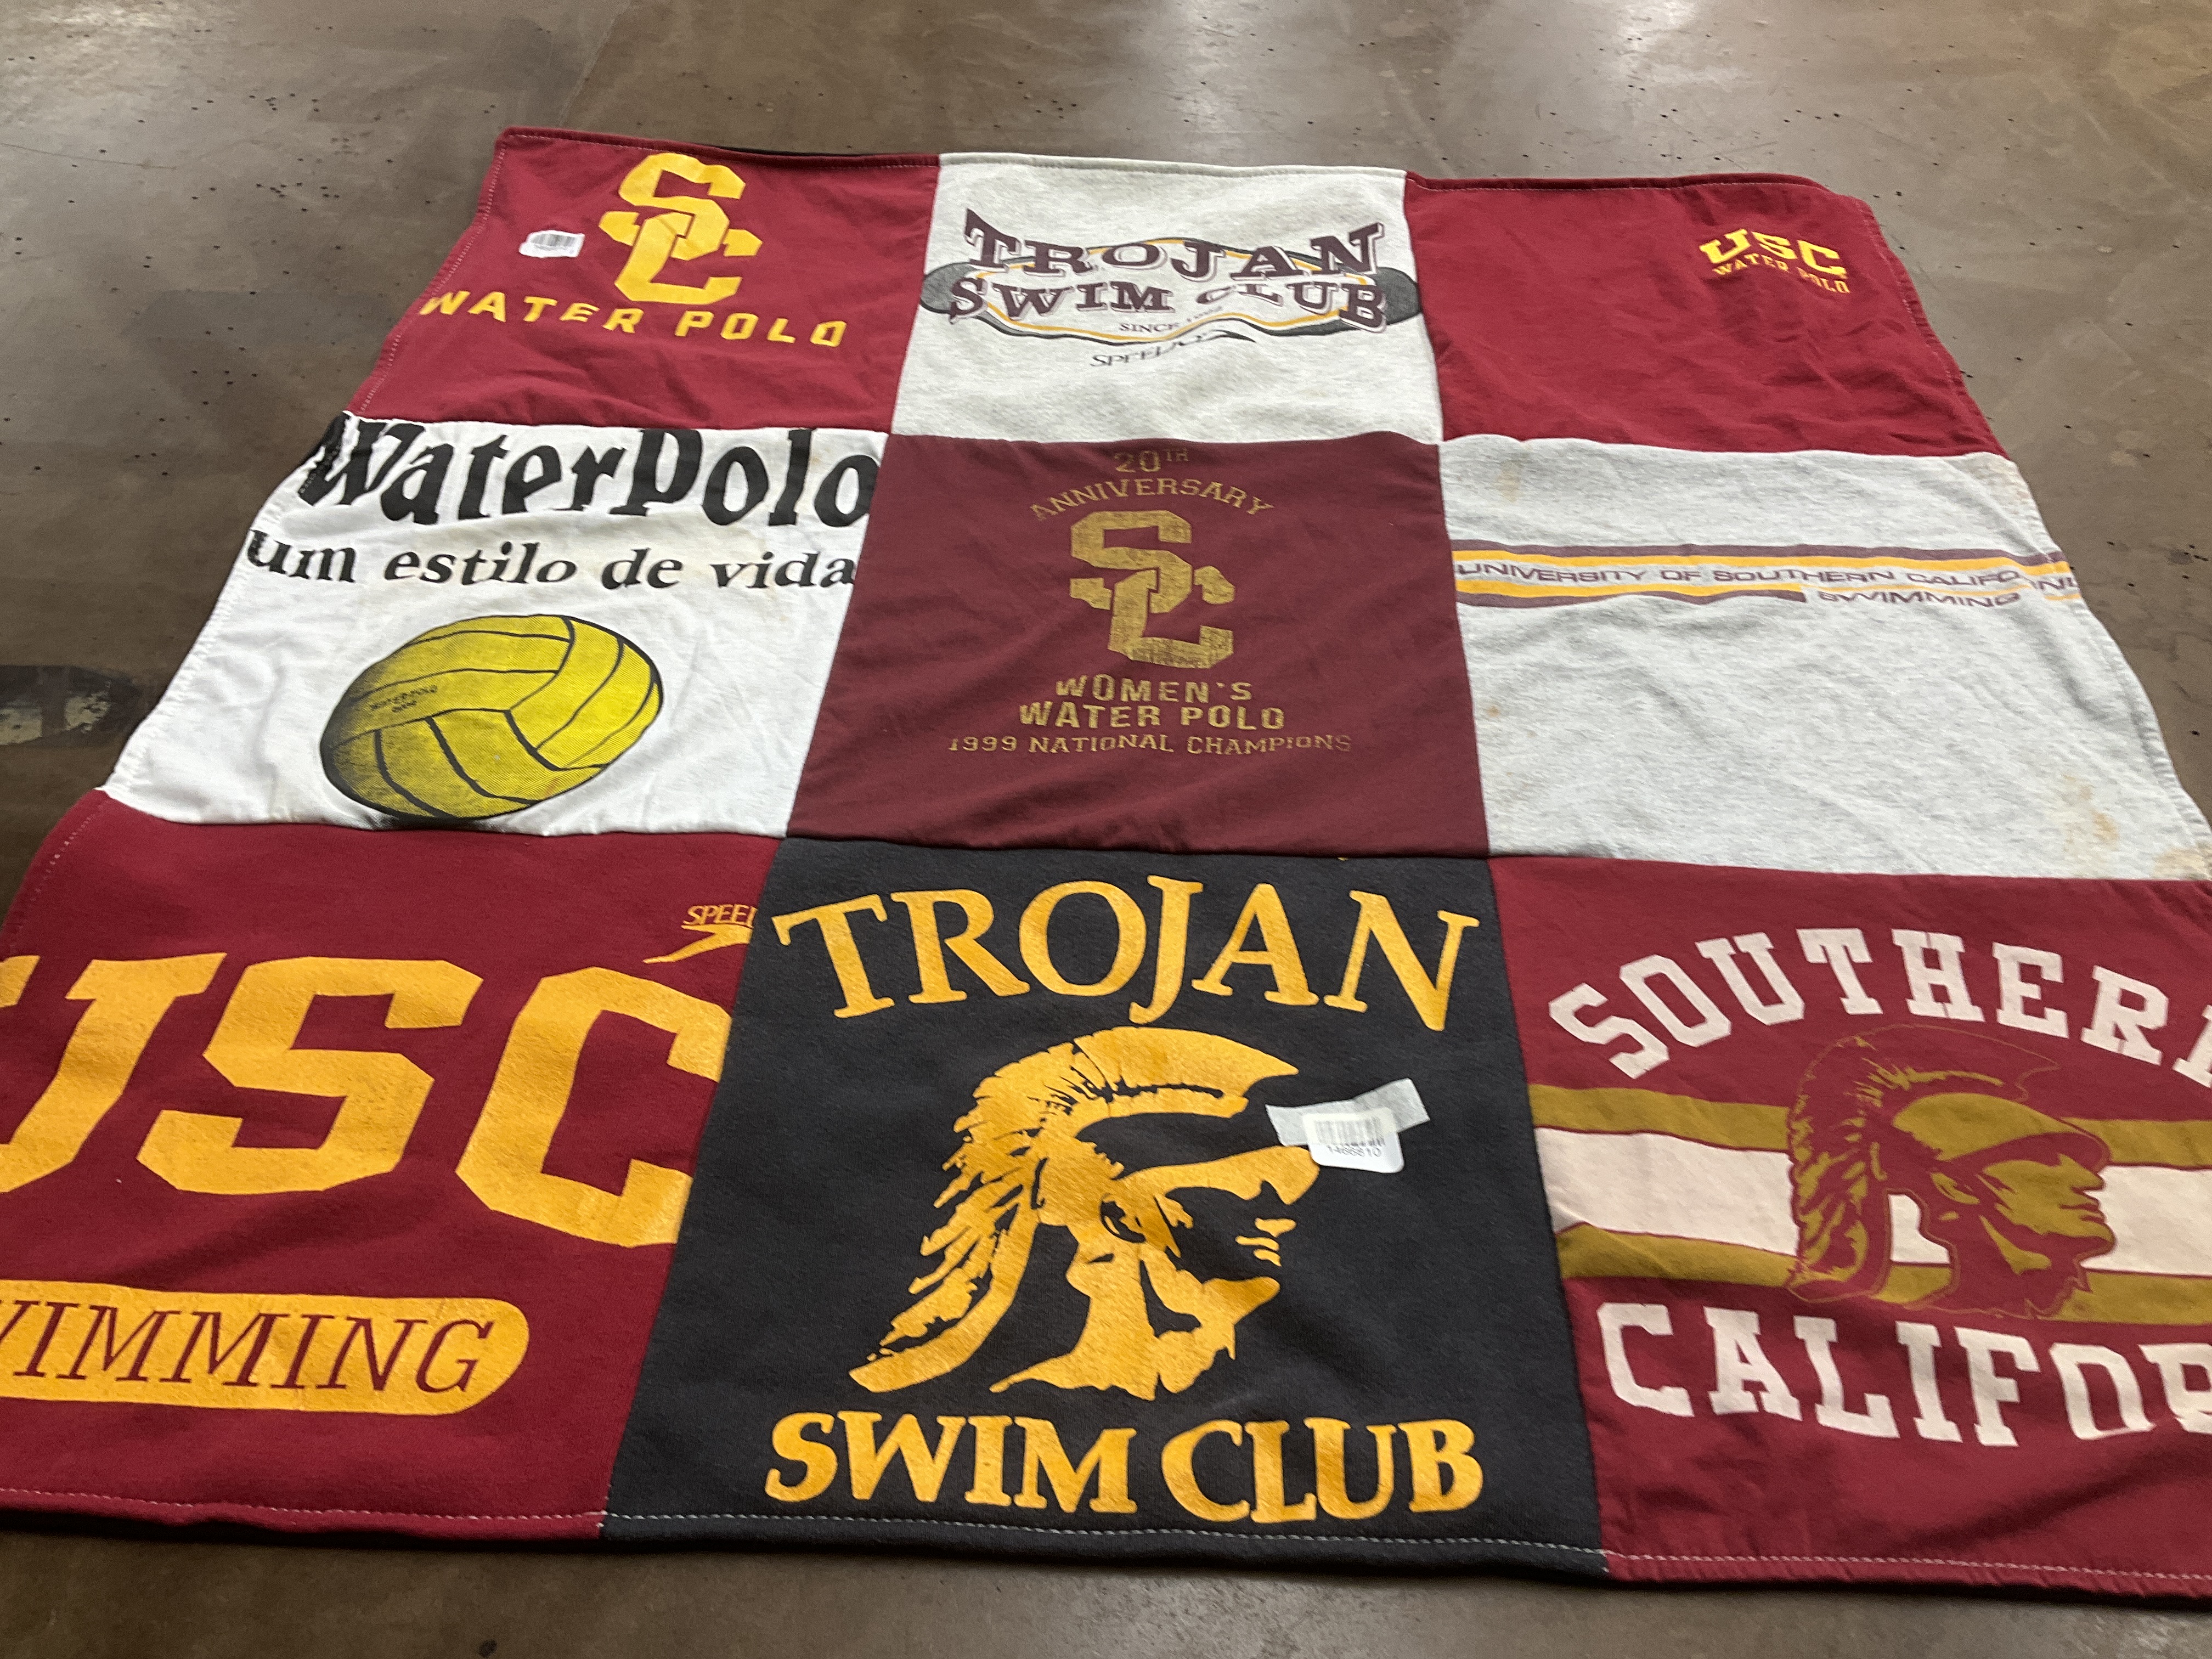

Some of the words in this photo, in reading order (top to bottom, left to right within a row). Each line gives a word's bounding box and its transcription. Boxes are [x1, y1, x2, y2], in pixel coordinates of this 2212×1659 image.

[964, 208, 1384, 281] TROJAN
[1700, 229, 1848, 279] USC
[1712, 253, 1791, 275] WATER
[419, 290, 645, 333] WATER
[675, 311, 847, 347] POLO
[948, 276, 1175, 324] SWIM
[1195, 281, 1387, 333] CLUB
[1030, 478, 1275, 521] ANNIVERSARY
[247, 529, 356, 583] um
[384, 542, 577, 585] estilo
[602, 548, 682, 589] de
[709, 551, 855, 589] vida
[1457, 563, 1645, 583] UNIVERSITY
[1661, 569, 1702, 582] OF
[1714, 569, 1894, 583] SOUTHERN
[1818, 591, 2021, 607] SWIMMING
[1056, 674, 1252, 704] WOMEN'S
[1019, 701, 1161, 729] WATER
[1181, 707, 1286, 730] POLO
[949, 736, 1018, 752] 1999
[1029, 733, 1175, 754] NATIONAL
[1187, 734, 1352, 755] CHAMPIONS
[772, 875, 1480, 1031] TROJAN
[765, 1410, 1137, 1513] SWIM
[1162, 1417, 1483, 1523] CLUB
